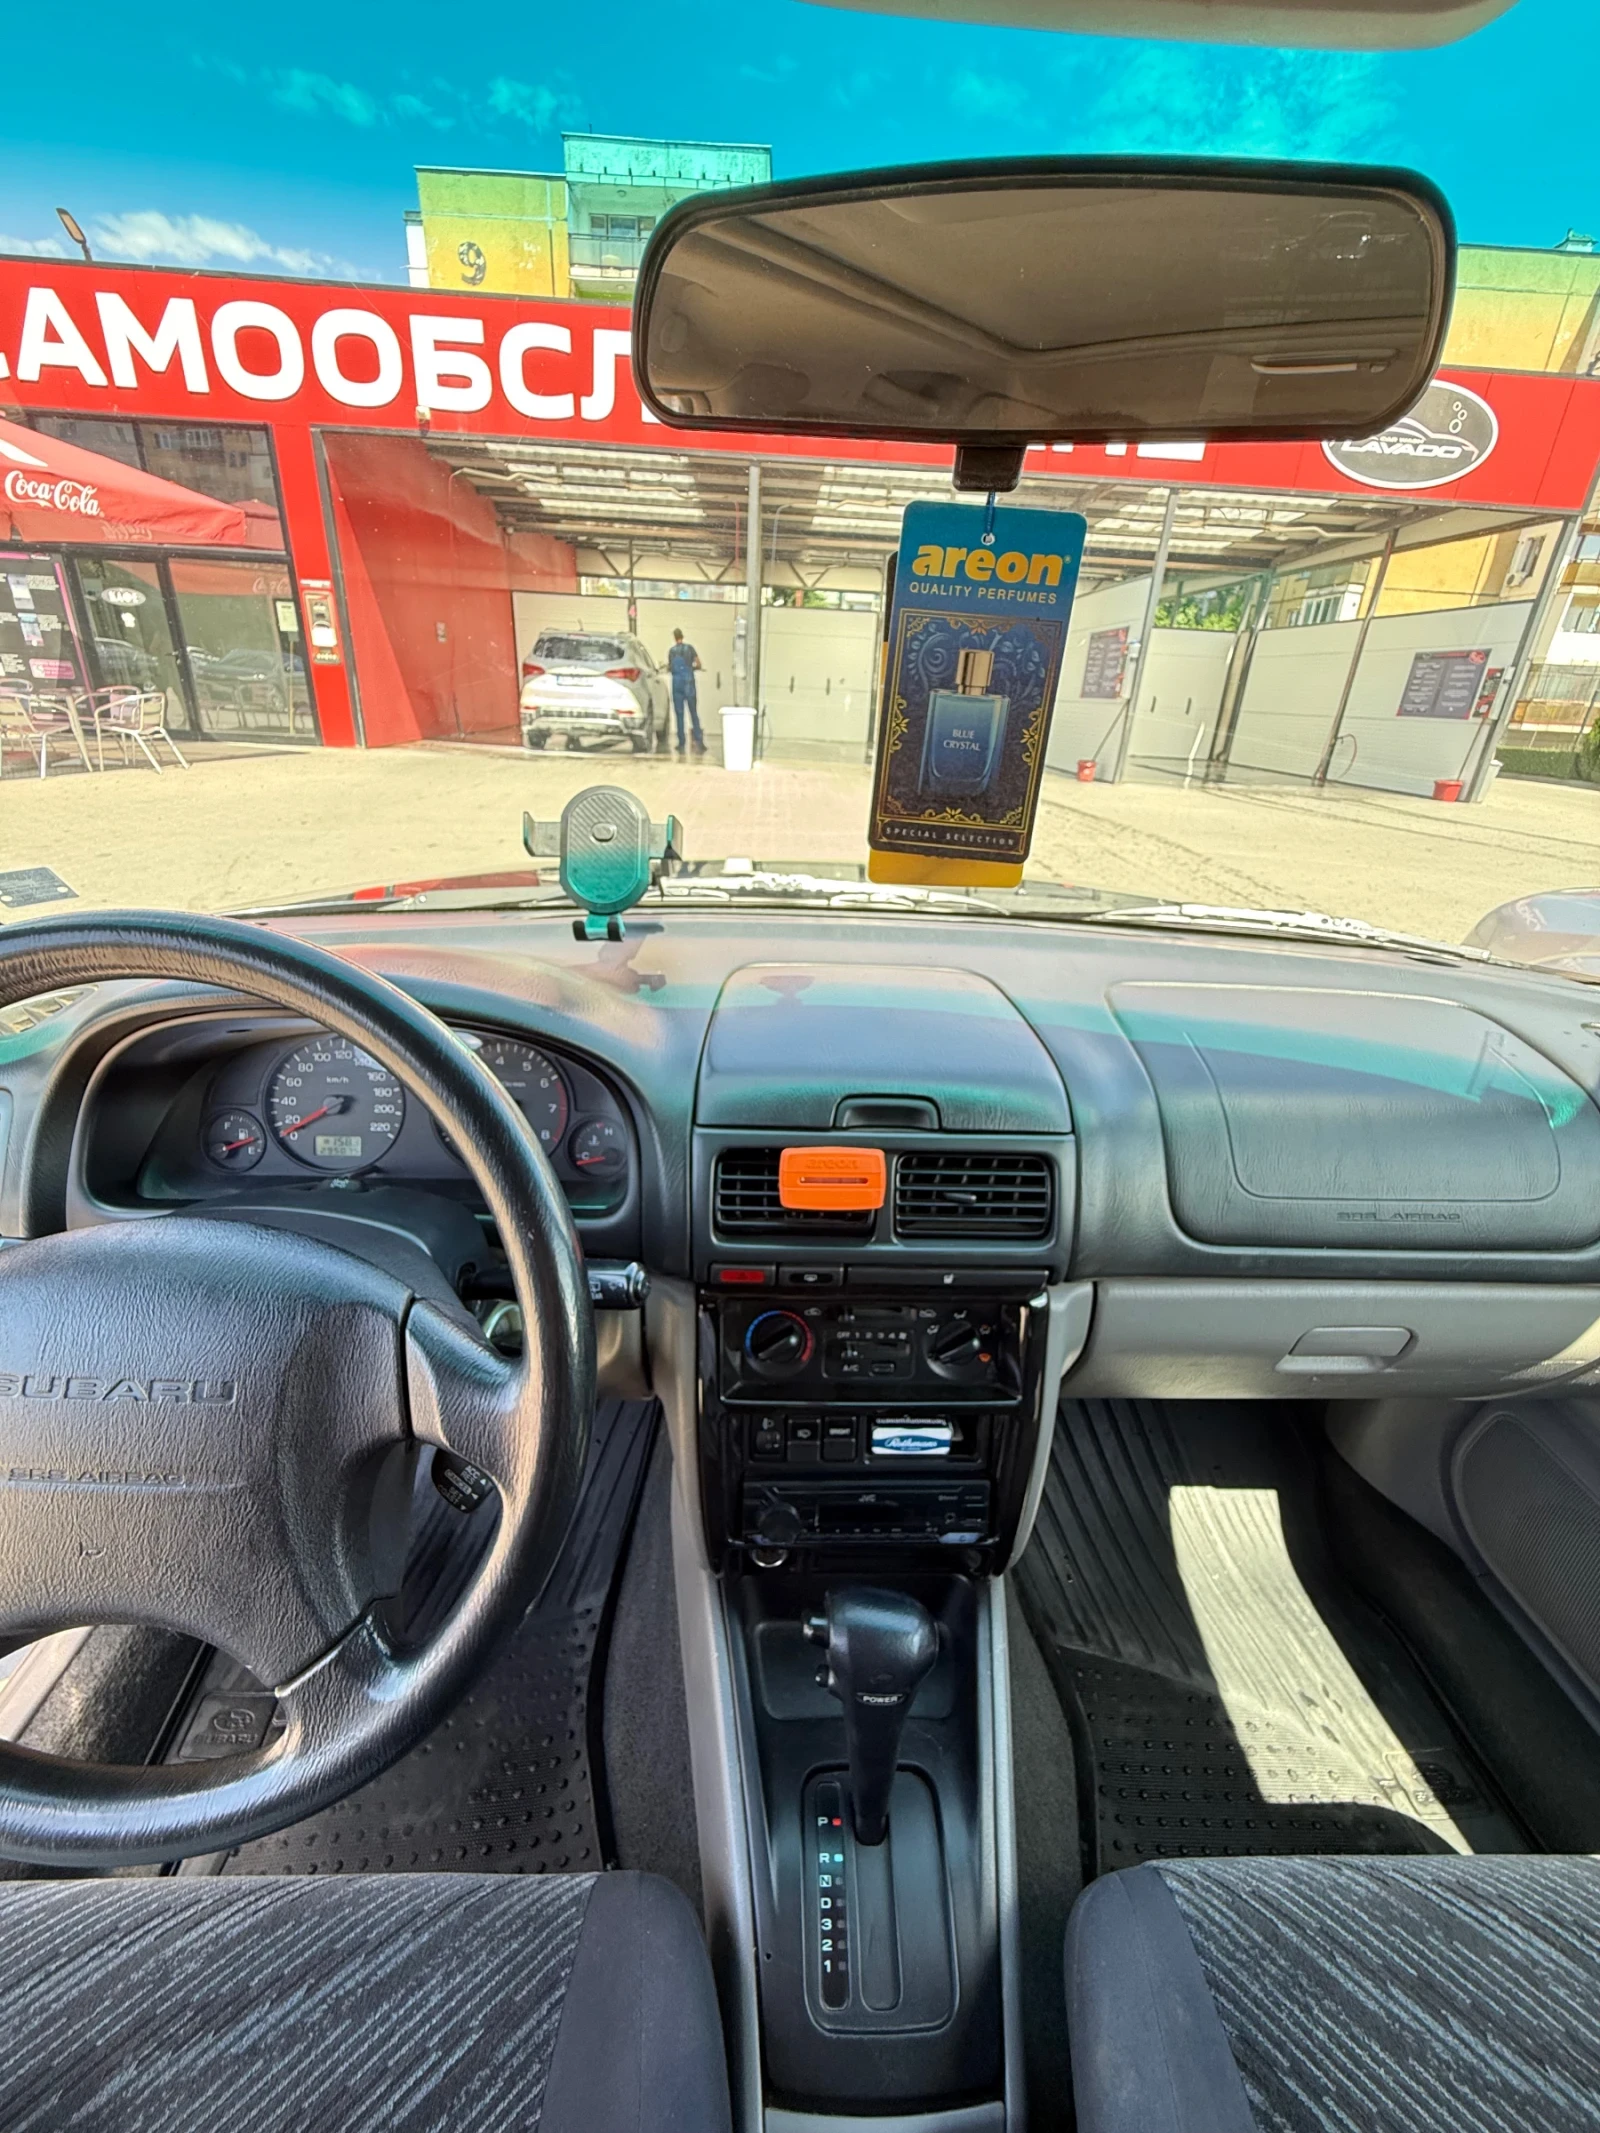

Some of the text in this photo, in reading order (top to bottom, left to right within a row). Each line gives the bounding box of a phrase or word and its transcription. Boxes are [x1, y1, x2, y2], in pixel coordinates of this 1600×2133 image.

[457, 241, 486, 285] 9
[1379, 435, 1425, 444] CAR WASH
[1340, 439, 1463, 459] LAVADO
[4, 470, 101, 516] Coca-Cola
[911, 545, 1063, 586] areon
[909, 581, 1058, 605] QUALITY PERFUMES
[952, 729, 976, 740] BLUE
[943, 739, 981, 752] CRYSTAL
[885, 826, 1016, 847] SPECIAL SELECTION
[312, 1052, 331, 1063] 100
[334, 1051, 353, 1060] 120
[495, 1056, 505, 1066] 4
[298, 1062, 314, 1073] 80
[522, 1062, 532, 1072] 5
[326, 1076, 349, 1084] km/h
[367, 1071, 386, 1082] 160
[286, 1077, 302, 1088] 60
[540, 1078, 549, 1089] 6
[373, 1087, 392, 1098] 180
[280, 1096, 297, 1107] 40
[374, 1104, 394, 1114] 200
[548, 1104, 557, 1114] 7
[285, 1114, 300, 1125] 20
[224, 1122, 231, 1131] F
[370, 1122, 390, 1133] 220
[605, 1128, 614, 1136] H
[290, 1131, 299, 1141] 0
[541, 1130, 550, 1141] 8
[581, 1152, 590, 1160] C
[842, 1364, 859, 1372] A/C
[0, 1374, 238, 1404] SUBARU
[863, 1695, 899, 1704] POWER
[817, 1816, 829, 1827] P
[819, 1852, 830, 1863] R
[820, 1875, 832, 1887] N
[820, 1898, 832, 1909] D
[821, 1918, 833, 1931] 3
[821, 1939, 833, 1951] 2
[824, 1960, 832, 1973] 1
